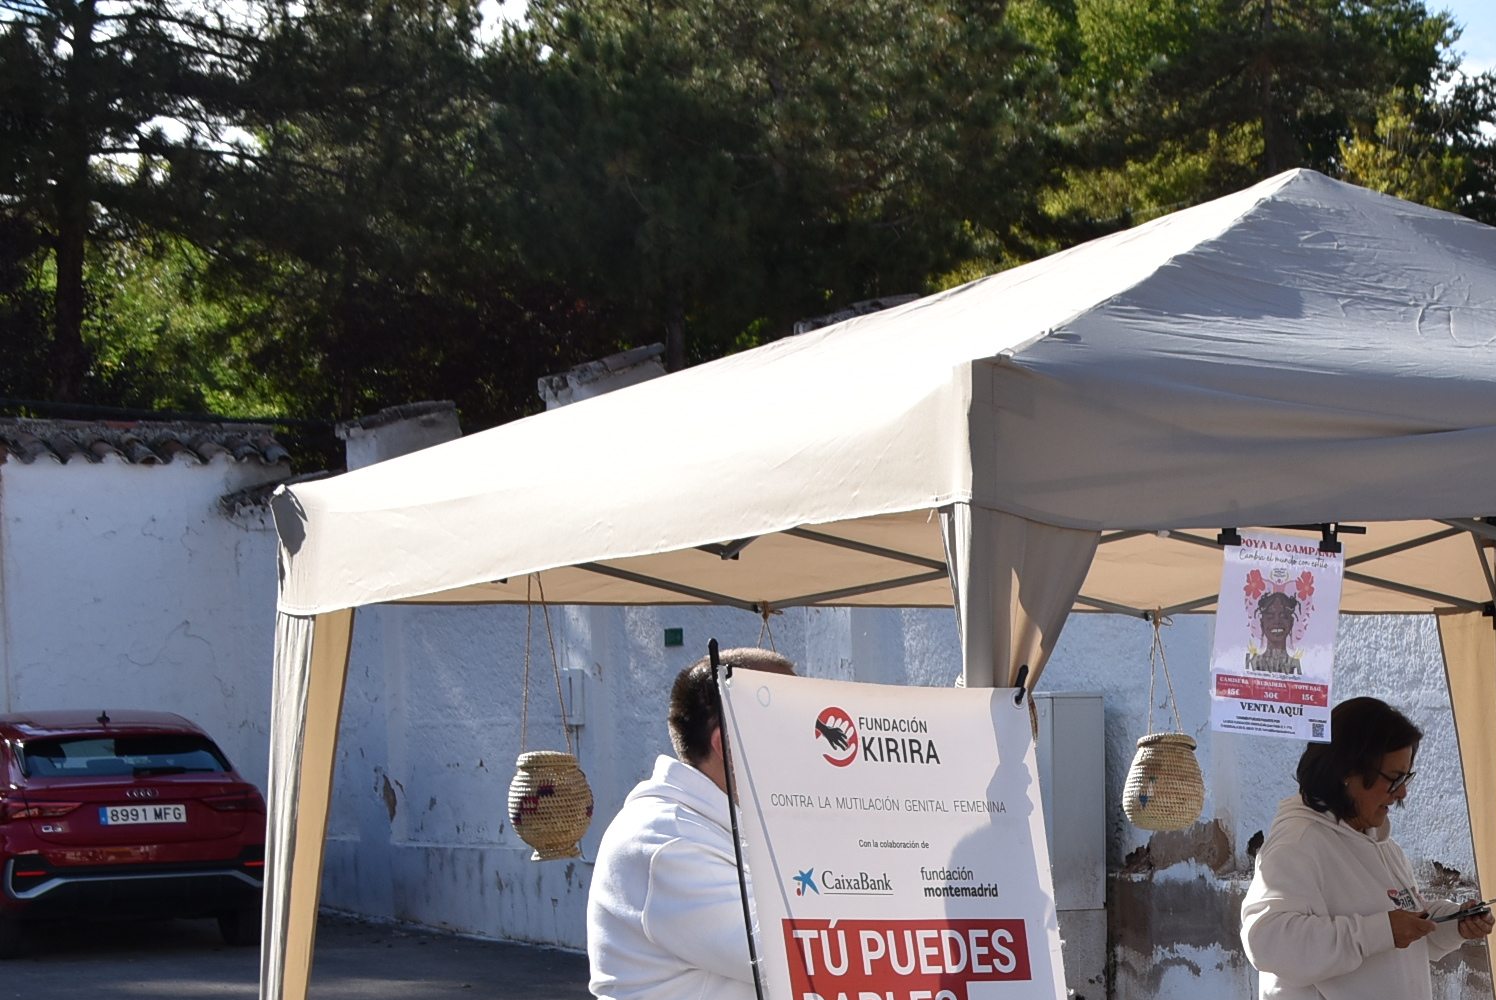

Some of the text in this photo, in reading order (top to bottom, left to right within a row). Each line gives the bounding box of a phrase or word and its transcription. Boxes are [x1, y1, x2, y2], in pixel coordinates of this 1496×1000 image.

[1241, 538, 1267, 549] POYA
[1270, 541, 1283, 552] LA
[1274, 555, 1298, 566] mundo
[1240, 701, 1303, 717] VENTA AQUÍ
[858, 716, 928, 733] FUNDACIÓN
[861, 736, 941, 765] KIRIRA
[770, 793, 1007, 814] CONTRA LA MUTILACIÓN GENITAL FEMENINA
[110, 807, 182, 822] 8991 MFG
[858, 839, 930, 849] Con la colaboración de
[821, 870, 893, 891] CaixaBank
[920, 866, 974, 881] fundación
[923, 883, 999, 898] montemadrid
[792, 919, 1017, 976] TÚ PUEDES
